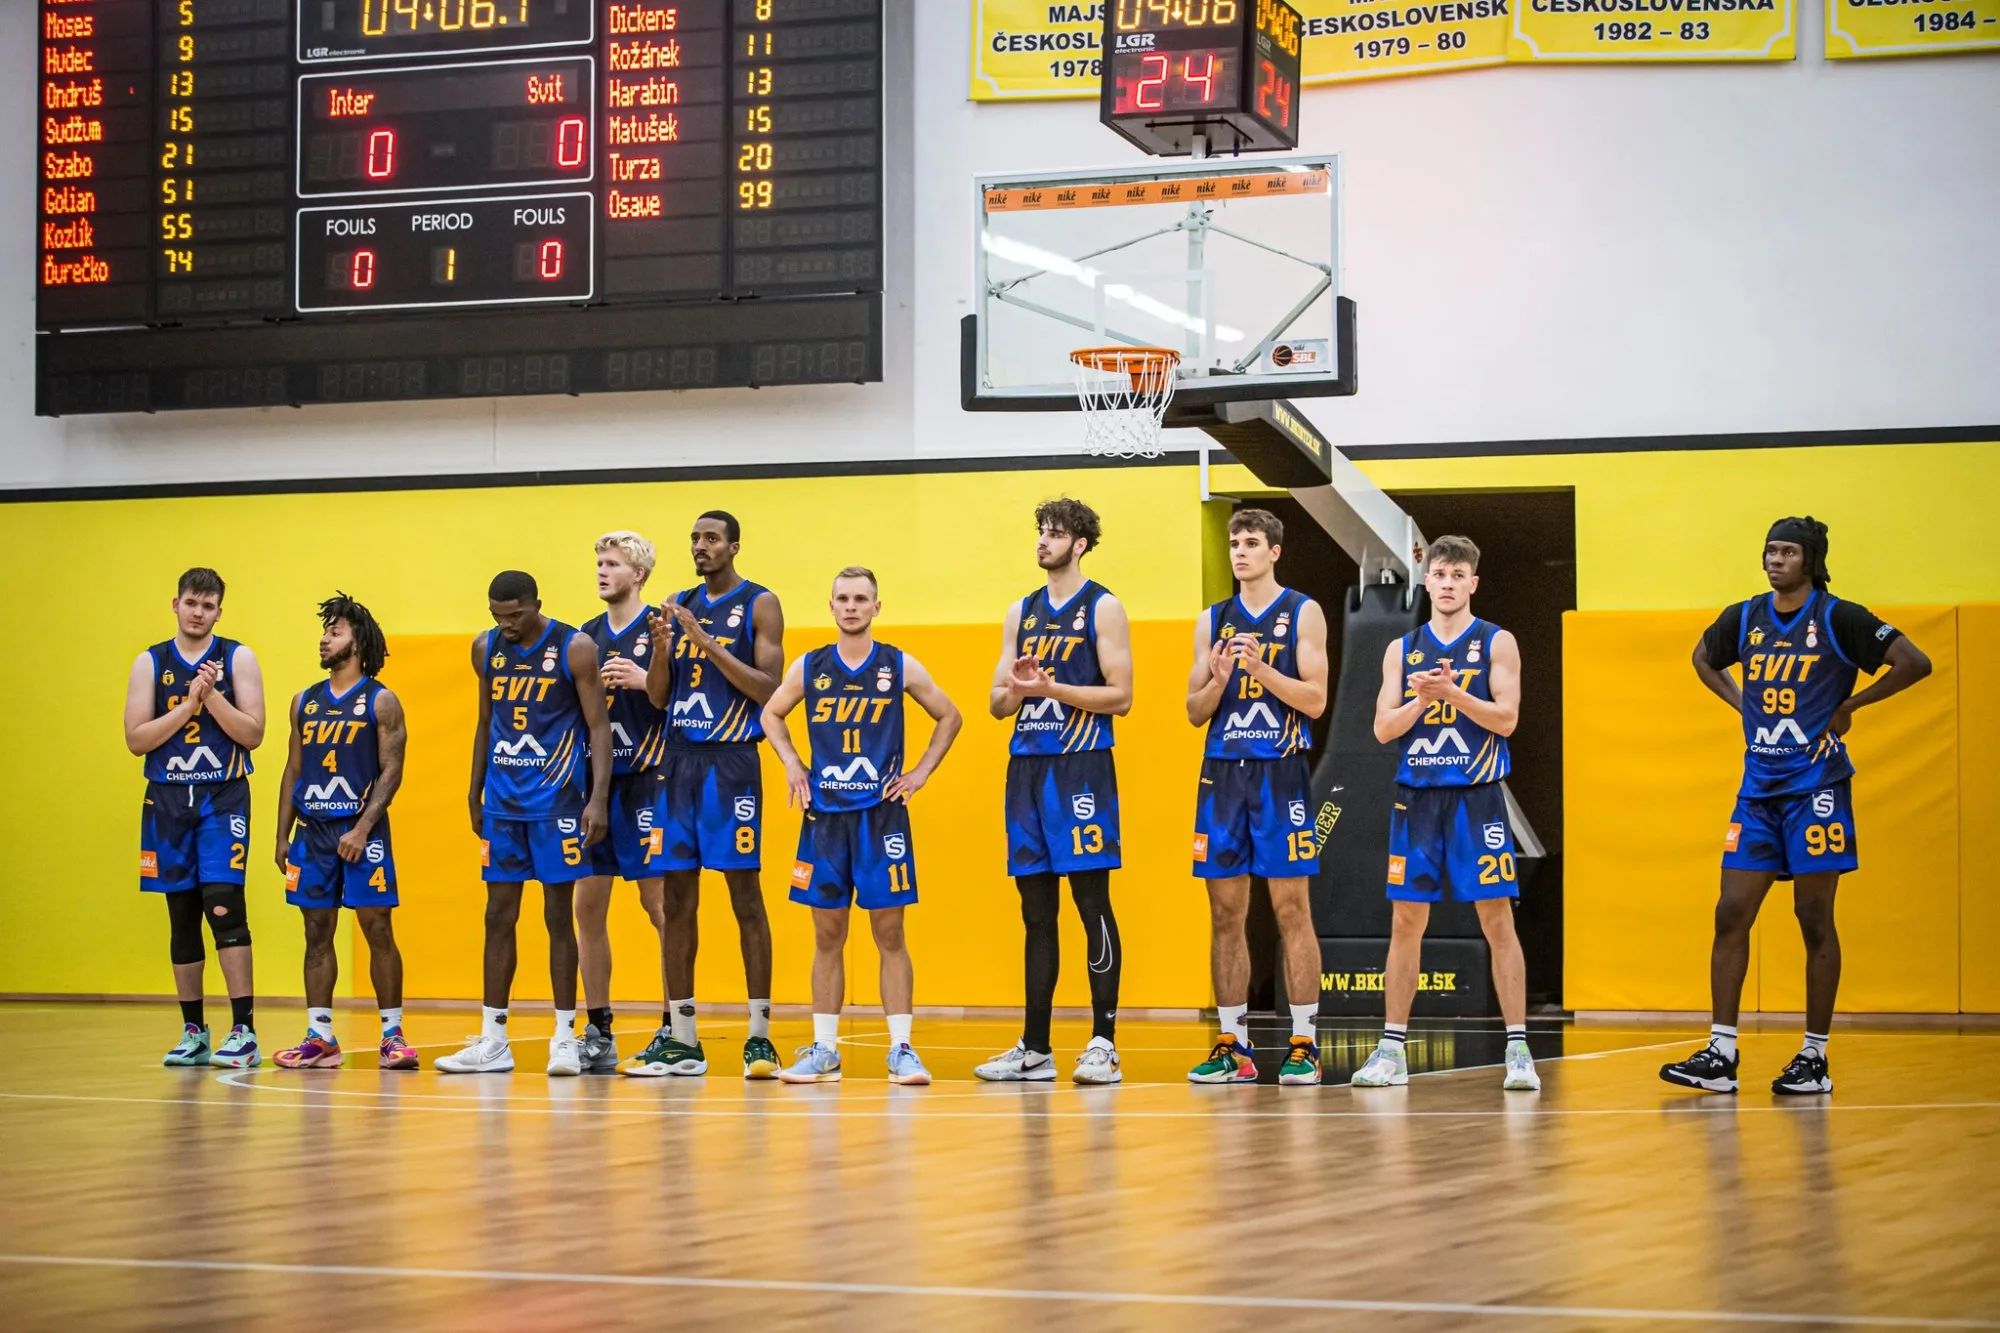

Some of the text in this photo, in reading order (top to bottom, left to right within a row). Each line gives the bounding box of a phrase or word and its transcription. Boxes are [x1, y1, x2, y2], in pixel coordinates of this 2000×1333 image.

[179, 0, 194, 26] 5
[609, 5, 676, 34] Dickens
[1914, 11, 1975, 32] 1984
[46, 12, 194, 61] Moses 9
[992, 32, 1103, 52] ČESKOSL
[1116, 33, 1155, 48] LGR
[1354, 37, 1410, 59] 1979
[1437, 31, 1466, 51] 80
[1594, 22, 1652, 40] 1982
[1680, 22, 1709, 40] 83
[307, 47, 328, 58] LGR
[609, 33, 772, 71] Rožánek 11
[46, 46, 194, 96] Hudec 13
[1050, 59, 1102, 77] 1978
[1136, 55, 1215, 108] 24
[527, 74, 564, 104] Svit
[609, 68, 772, 107] Harabin 13
[1257, 60, 1291, 128] 24
[46, 79, 193, 132] Ondruš 15
[330, 88, 374, 116] Inter
[609, 106, 771, 144] Matušek 15
[45, 116, 193, 168] Sudžum 21
[368, 131, 393, 177] 0
[558, 119, 583, 166] 0
[609, 144, 772, 181] Turza 20
[45, 151, 193, 204] Szabo 51
[609, 180, 772, 218] Osawe 99
[44, 187, 192, 240] Golian 55
[326, 208, 566, 236] FOULS PERIOD FOULS
[44, 217, 193, 272] Kozlík 74
[44, 255, 108, 285] Ďurečko
[353, 241, 562, 287] 0 1 0
[1022, 636, 1085, 661] SVIT
[1748, 654, 1821, 682] SVIT
[492, 676, 557, 702] SVIT
[1239, 675, 1263, 699] 15
[1763, 687, 1796, 714] 99
[513, 707, 528, 731] 5
[811, 697, 892, 723] SVIT
[1424, 700, 1457, 725] 20
[184, 721, 200, 743] 2
[302, 720, 367, 745] SVIT
[842, 728, 861, 753] 11
[166, 770, 222, 780] CHEMOSVIT
[322, 749, 337, 773] 4
[493, 756, 546, 767] CHEMOSVIT
[1407, 756, 1470, 766] CHEMOSVIT
[819, 780, 879, 790] CHEMOSVIT
[305, 801, 359, 810] CHEMOSVIT
[561, 837, 582, 866] 5
[736, 826, 755, 854] 8
[1071, 824, 1104, 855] 13
[1287, 830, 1316, 862] 15
[1805, 822, 1846, 856] 99
[230, 843, 245, 870] 2
[1477, 852, 1516, 885] 20
[368, 866, 387, 893] 4
[888, 862, 910, 892] 11
